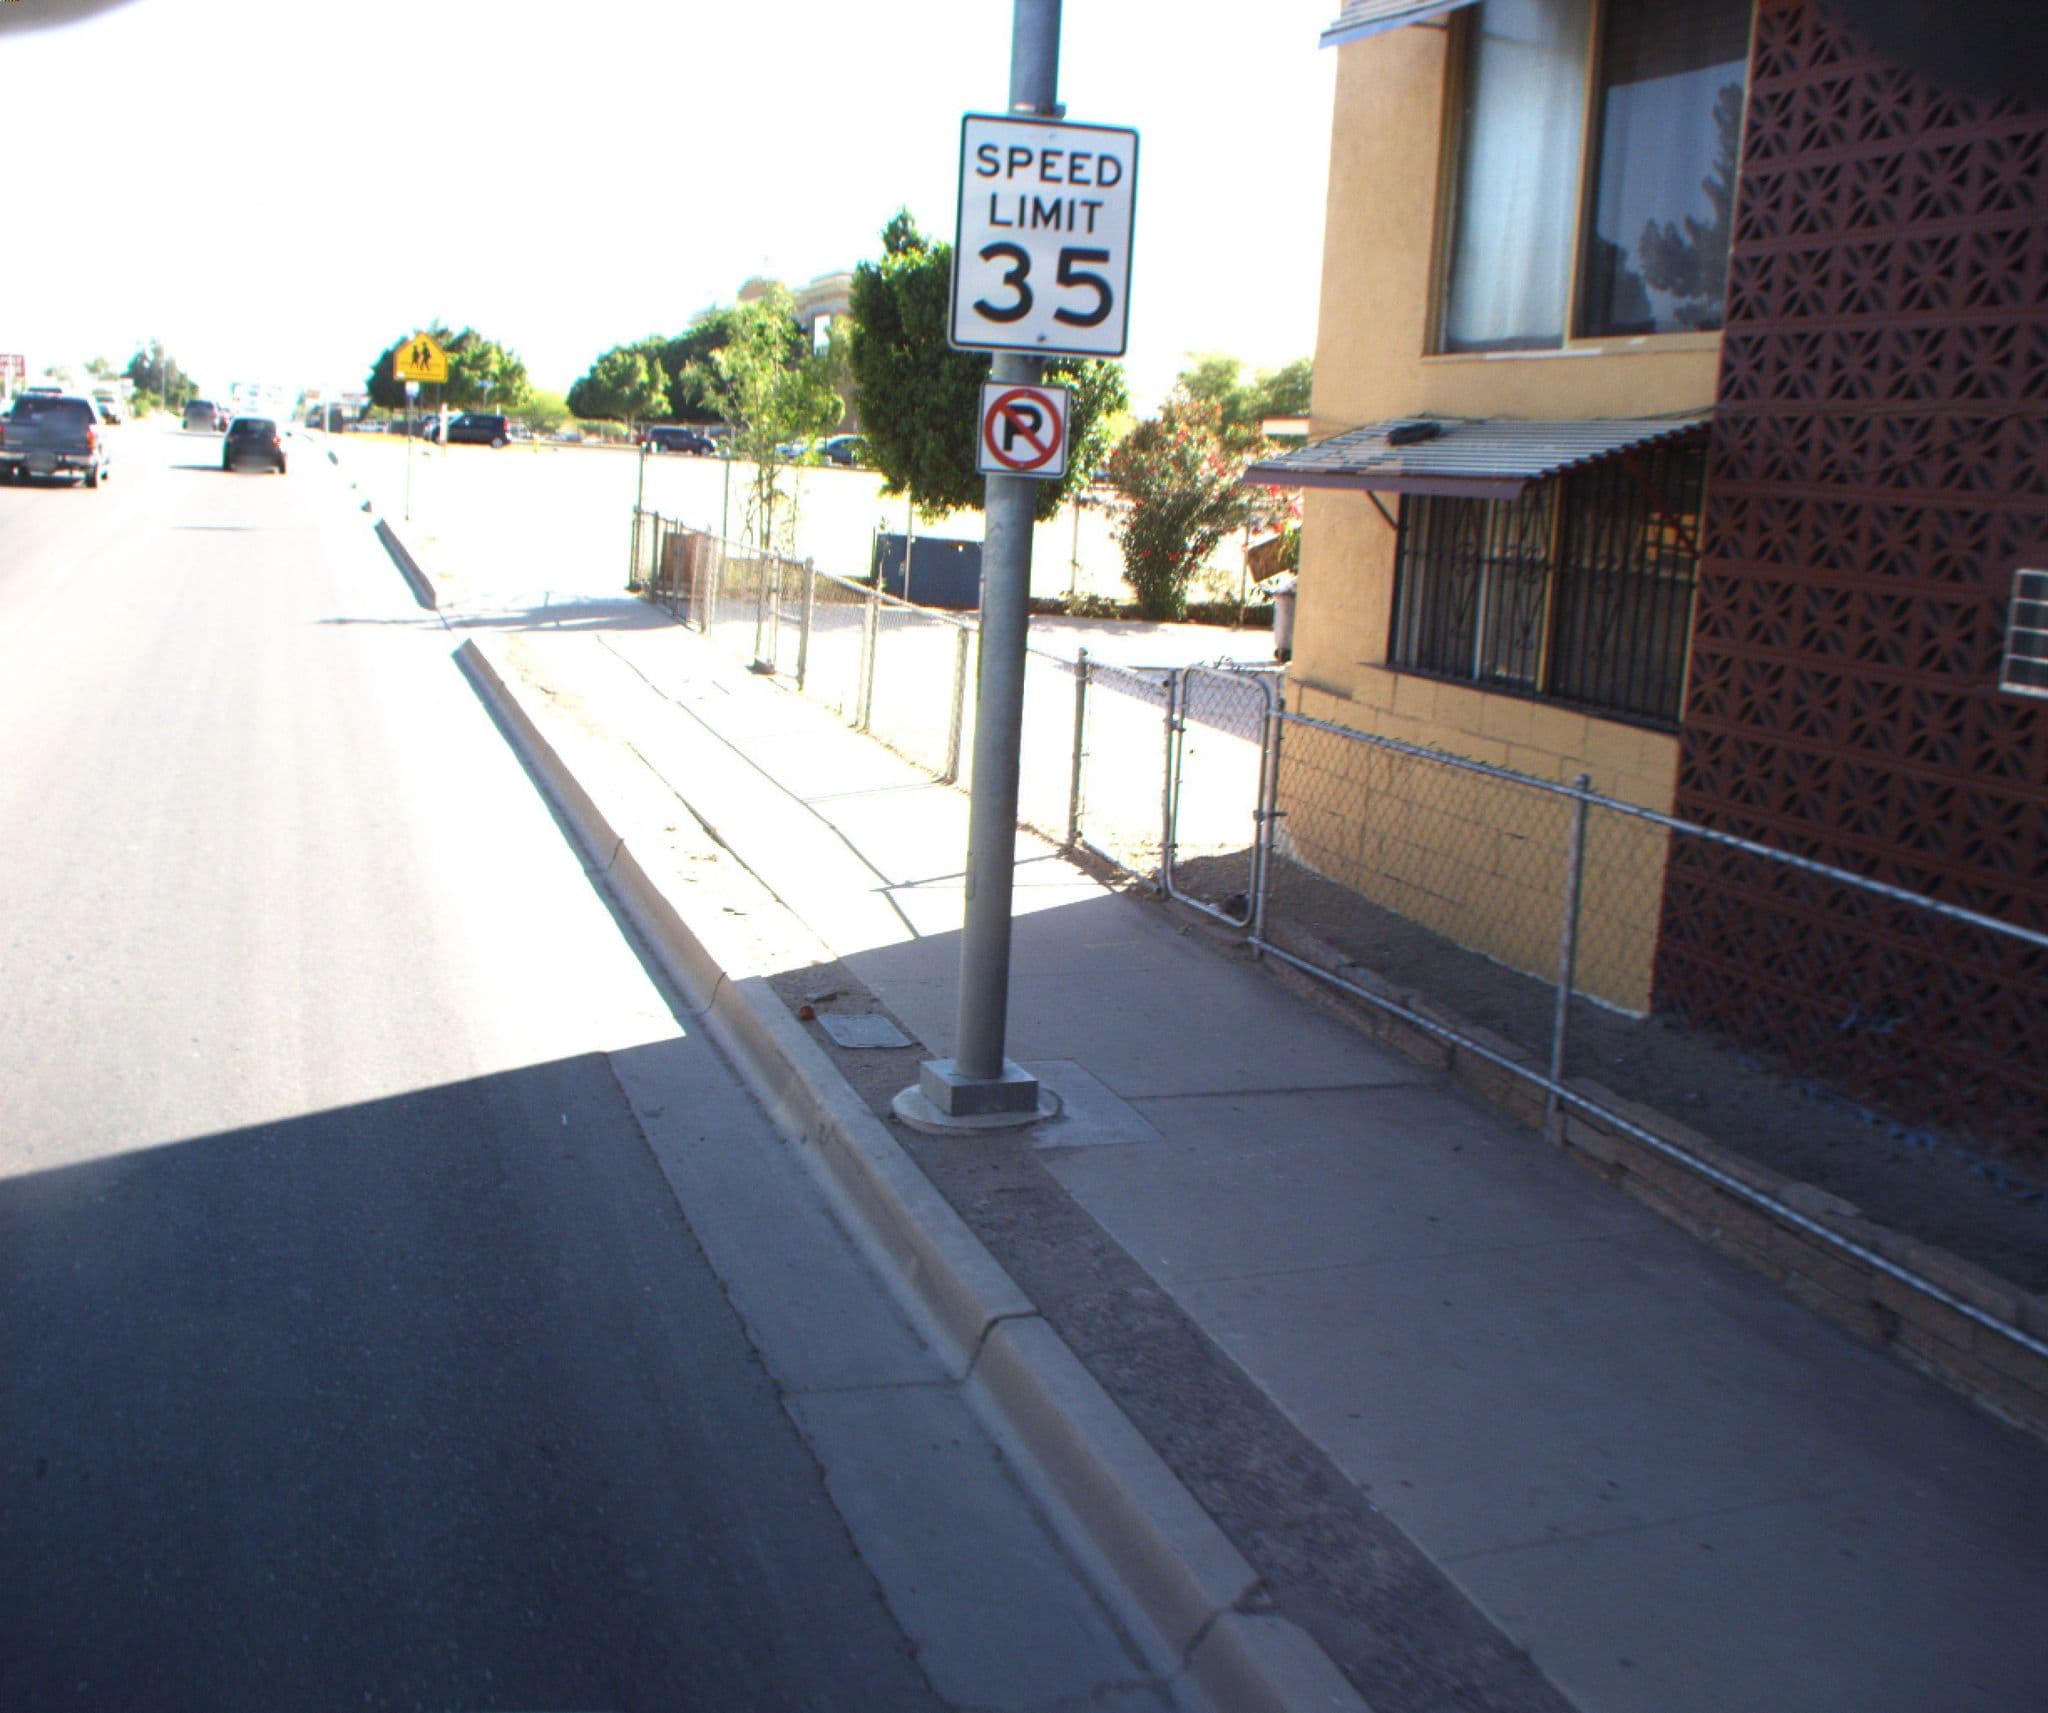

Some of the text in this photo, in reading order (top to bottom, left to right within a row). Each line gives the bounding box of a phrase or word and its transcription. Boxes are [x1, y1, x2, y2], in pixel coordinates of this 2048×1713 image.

[976, 144, 1123, 188] SPEED
[989, 193, 1104, 234] LIMIT
[972, 241, 1114, 329] 35
